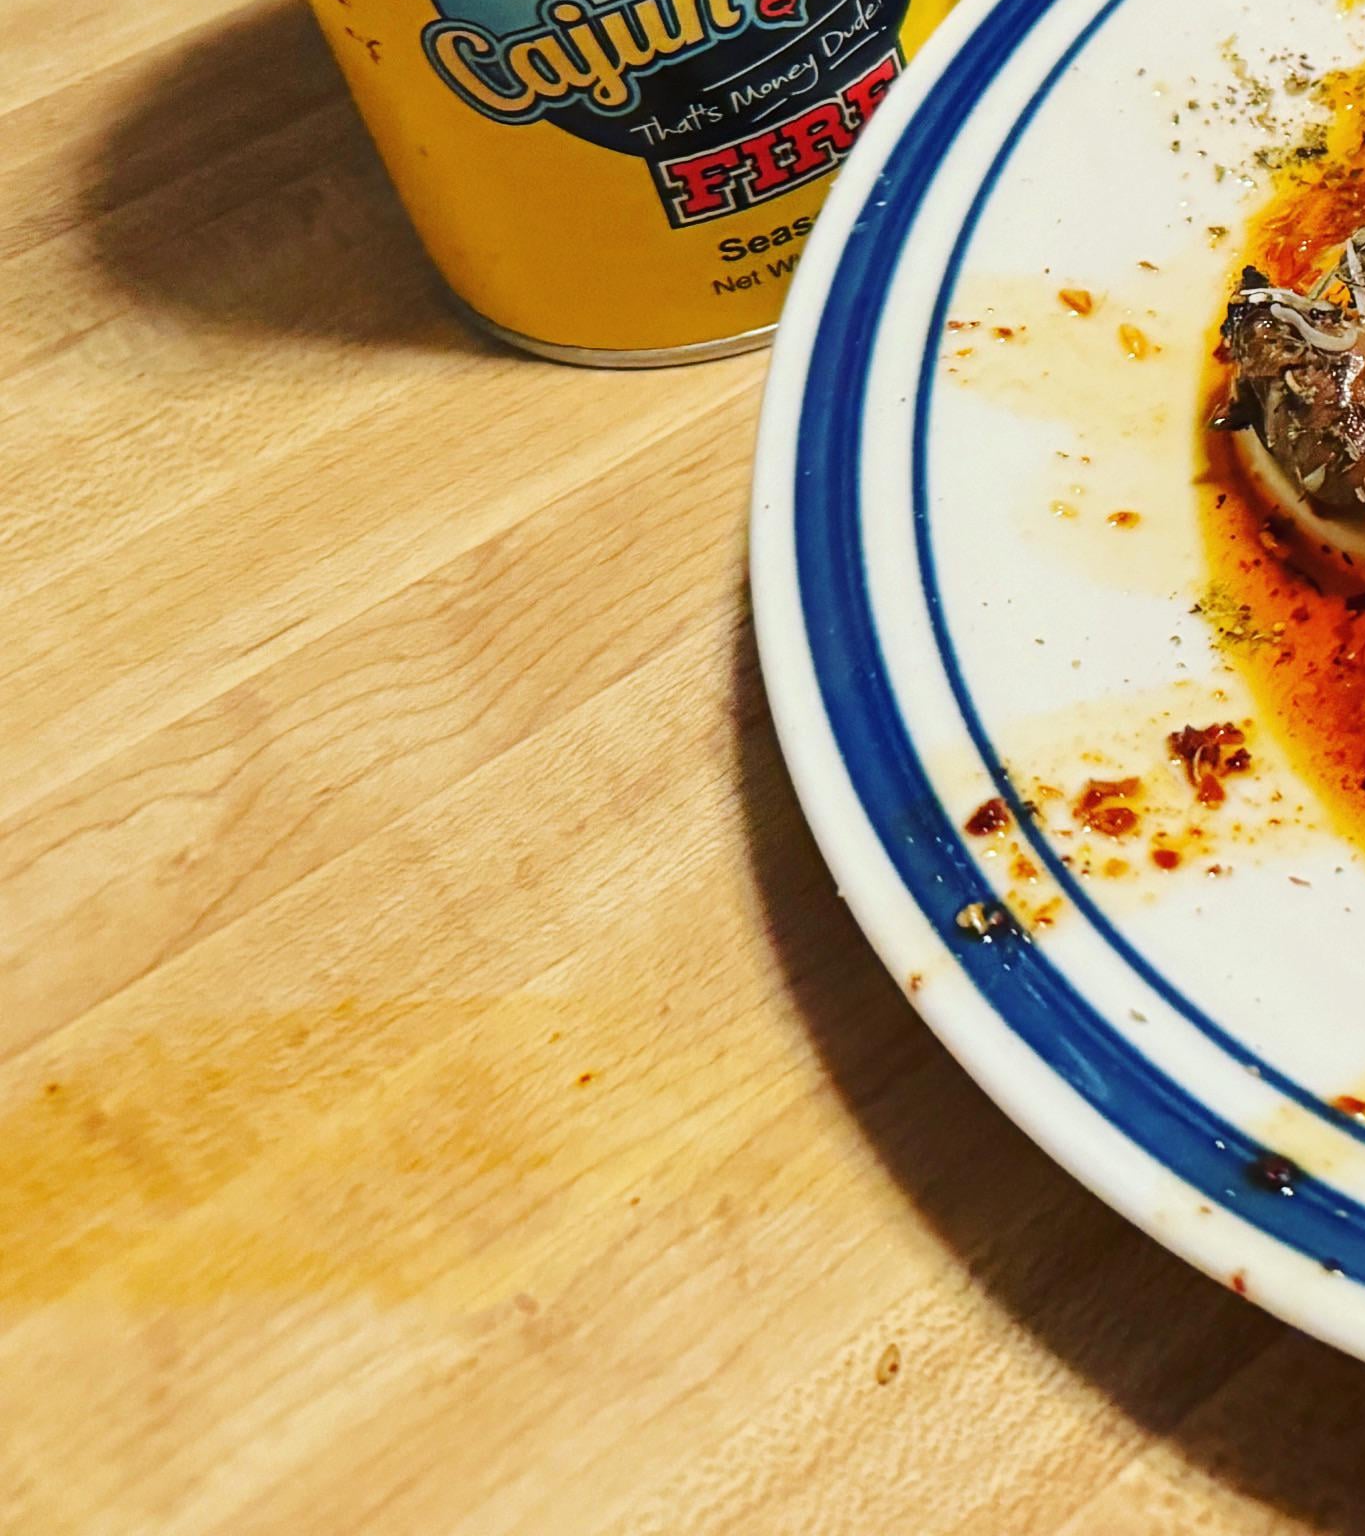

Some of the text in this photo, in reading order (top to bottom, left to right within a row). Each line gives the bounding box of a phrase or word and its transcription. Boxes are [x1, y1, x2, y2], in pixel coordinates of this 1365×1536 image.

[630, 102, 723, 146] That's
[730, 53, 819, 114] Money
[718, 214, 818, 262] Seas
[712, 253, 800, 296] Net W
